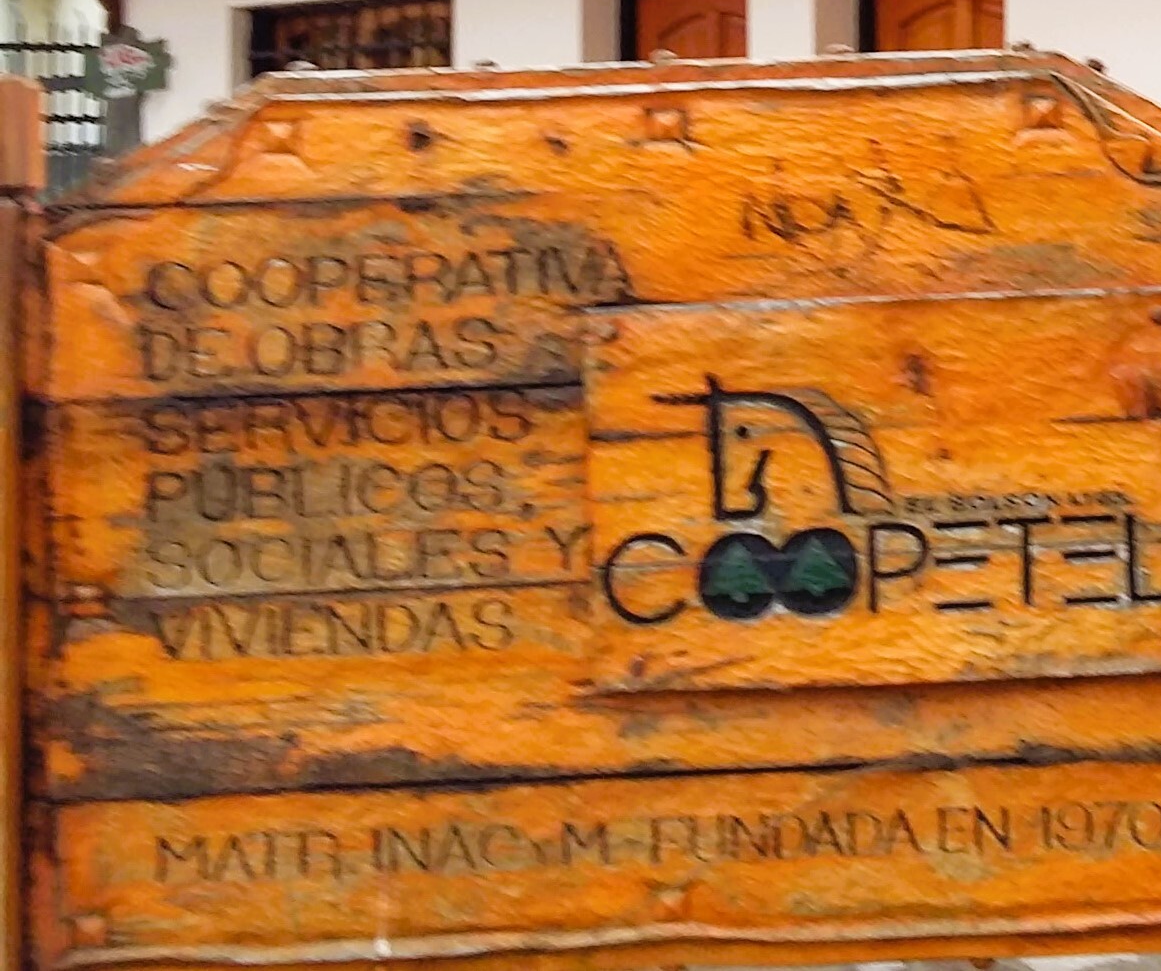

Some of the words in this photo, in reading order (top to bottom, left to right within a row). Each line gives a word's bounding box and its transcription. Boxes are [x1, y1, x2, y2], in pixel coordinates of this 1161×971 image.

[147, 238, 635, 310] COOPERATIVA
[138, 327, 232, 381] DE
[253, 316, 500, 377] OBRAS
[142, 388, 532, 456] SERVICIOS
[144, 530, 510, 590] SOCIALES
[544, 524, 595, 572] Y
[151, 596, 514, 660] VIVIENDAS
[936, 804, 1011, 856] EN
